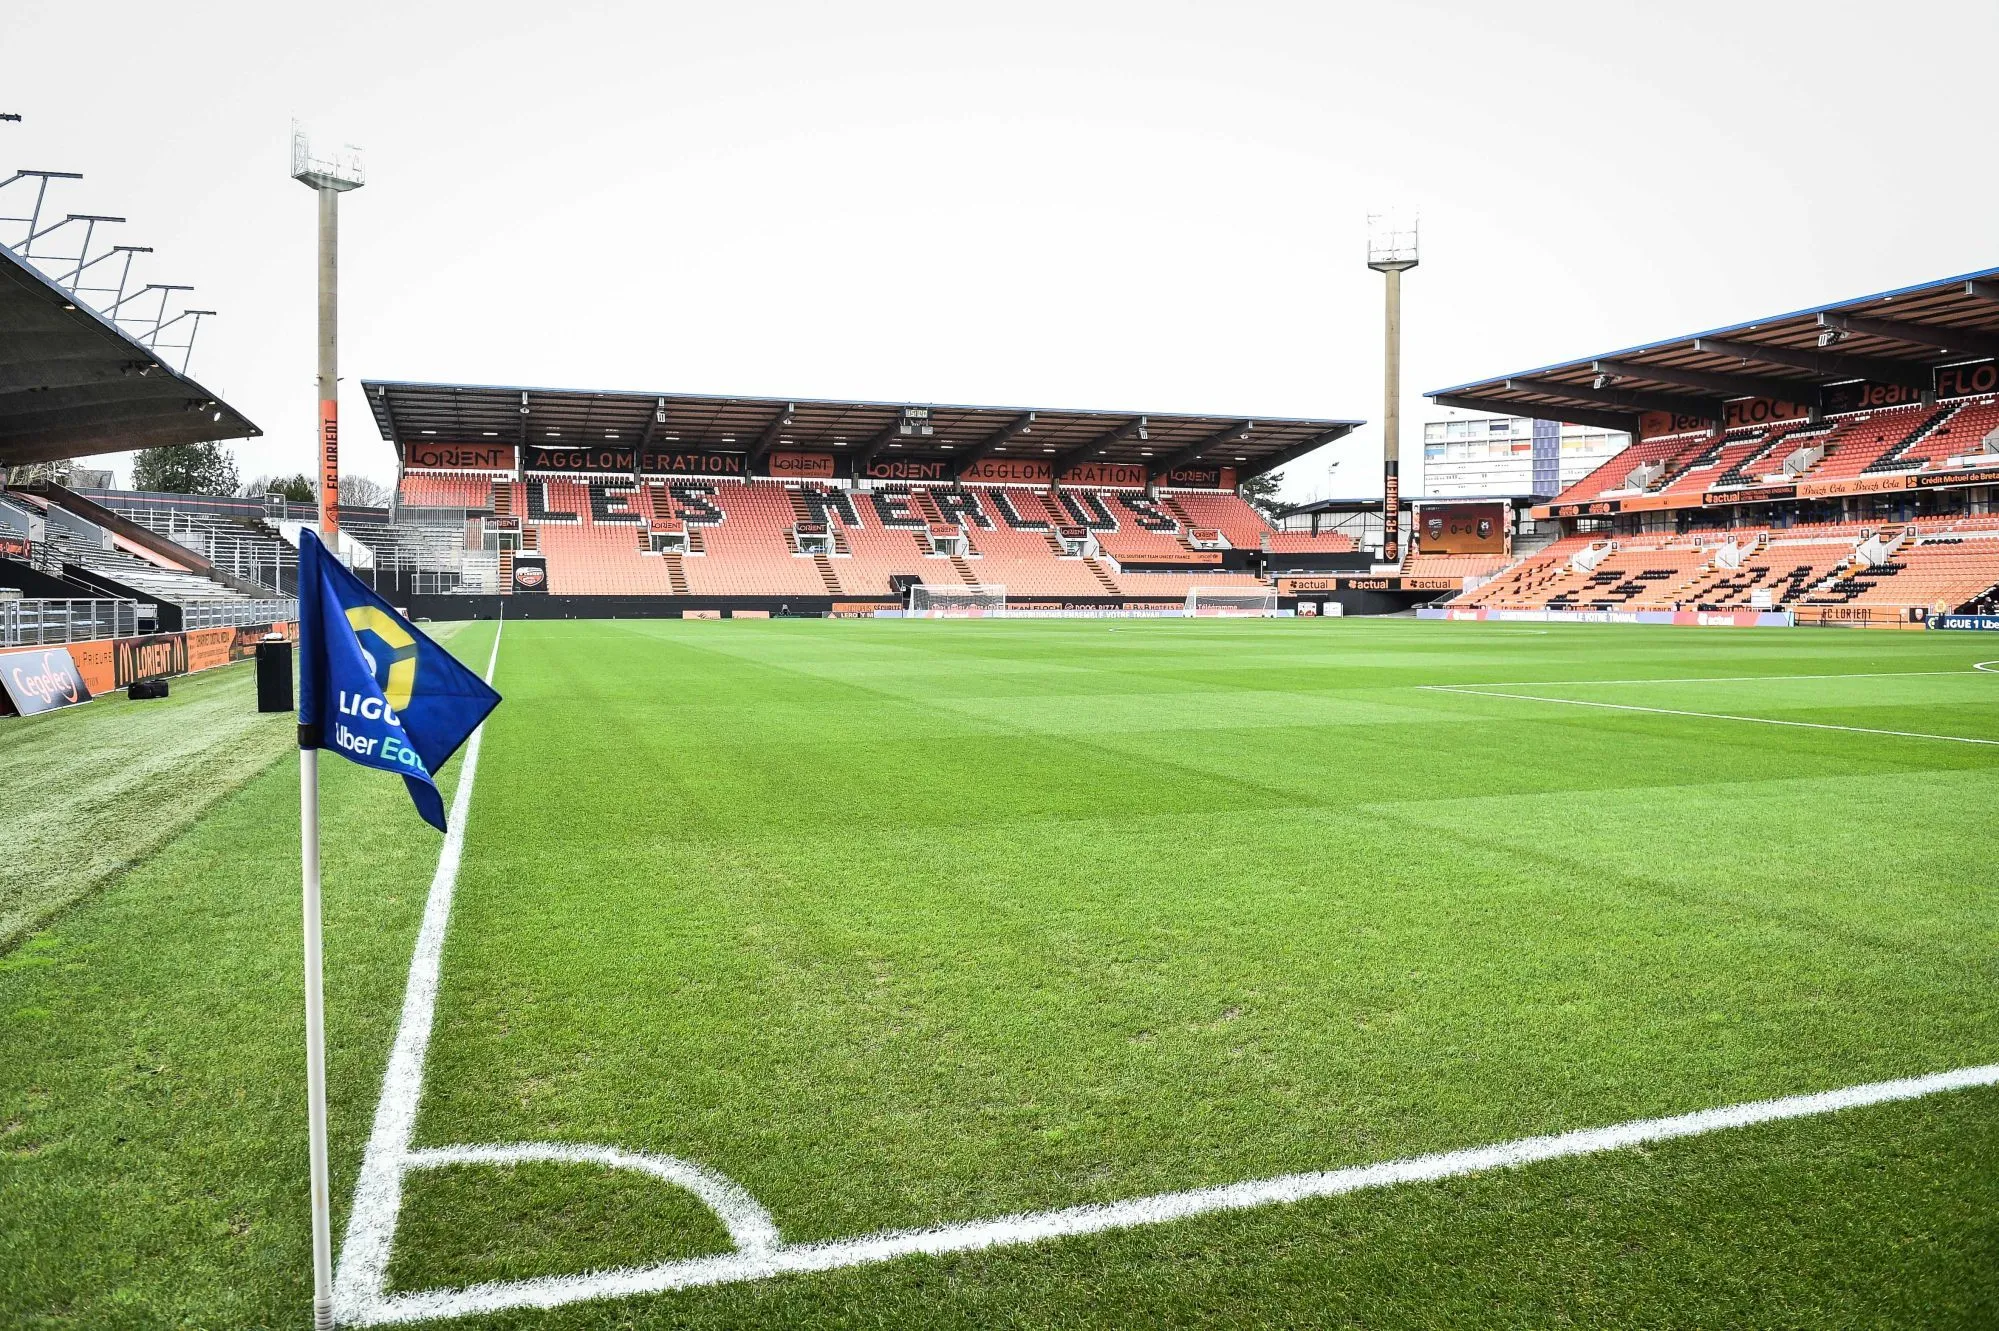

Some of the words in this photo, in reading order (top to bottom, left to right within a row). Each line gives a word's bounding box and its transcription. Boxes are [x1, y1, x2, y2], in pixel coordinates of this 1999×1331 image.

[1943, 474, 1969, 483] Mutuel
[1970, 473, 1980, 481] de
[1386, 475, 1398, 517] LORIENT
[1713, 491, 1740, 503] actual
[525, 478, 728, 528] LES
[799, 482, 1181, 535] MERLUS
[651, 520, 683, 529] LORIENT
[1386, 520, 1397, 533] FC
[1299, 579, 1328, 589] actual
[1357, 579, 1389, 590] actual
[1418, 579, 1451, 589] actual
[1973, 619, 1979, 629] 1
[135, 642, 171, 679] LORIENT
[340, 690, 406, 734] LIGU
[335, 722, 378, 755] Uber
